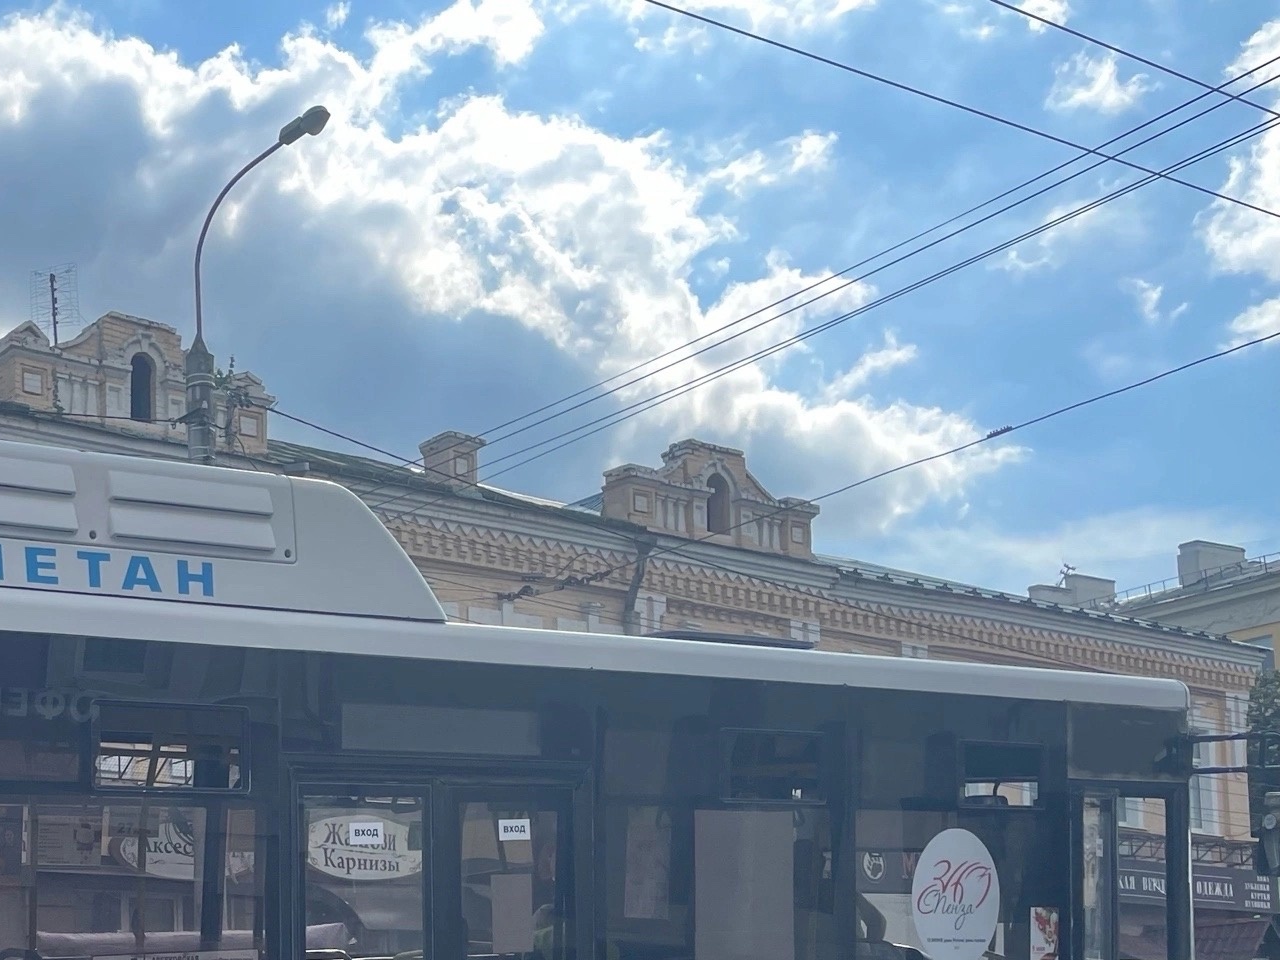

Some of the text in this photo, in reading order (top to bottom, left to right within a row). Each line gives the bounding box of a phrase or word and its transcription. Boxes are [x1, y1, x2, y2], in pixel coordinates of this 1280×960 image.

[354, 828, 379, 838] ВХОД
[503, 825, 526, 834] ВХОД
[321, 847, 400, 875] Карнизы
[1196, 881, 1233, 897] ОДЕЖДА
